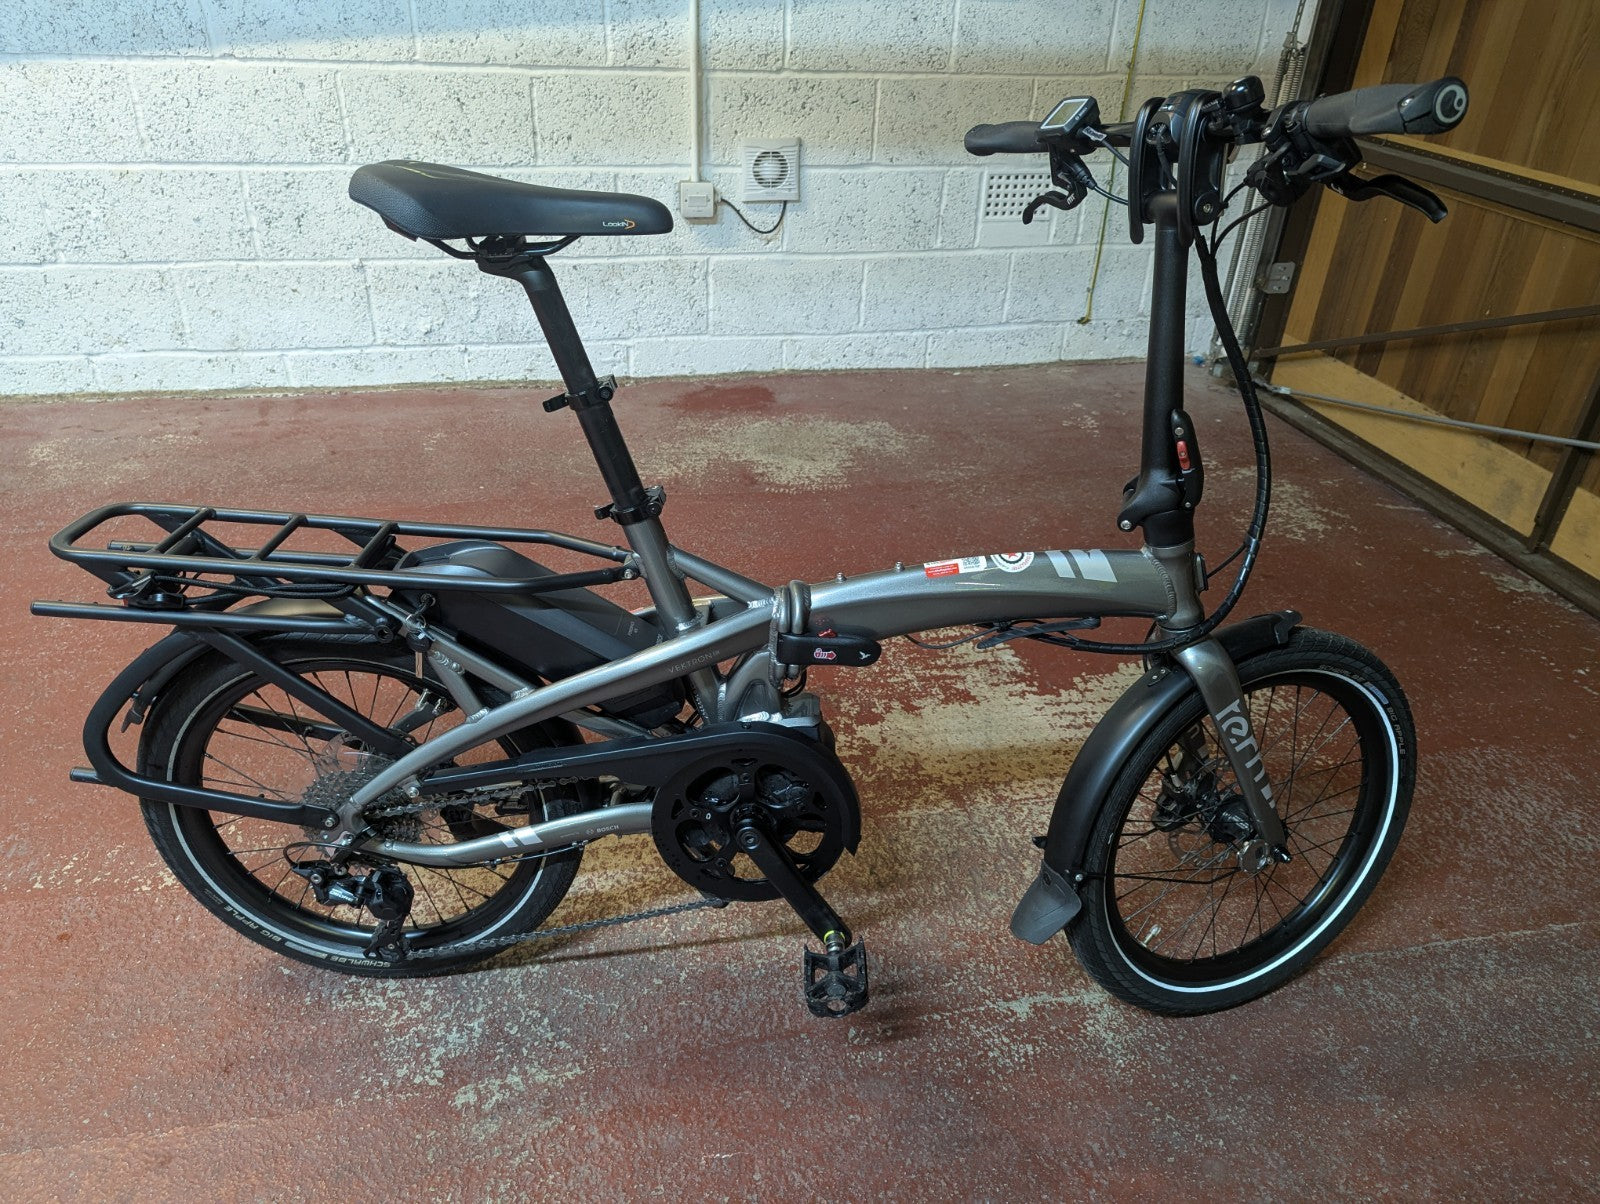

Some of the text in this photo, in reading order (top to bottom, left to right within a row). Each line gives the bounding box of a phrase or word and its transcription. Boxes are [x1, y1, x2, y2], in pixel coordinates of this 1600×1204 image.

[596, 824, 620, 833] BOSCH
[224, 905, 282, 942] BIG APPLE
[330, 956, 391, 968] SCHWALBE
